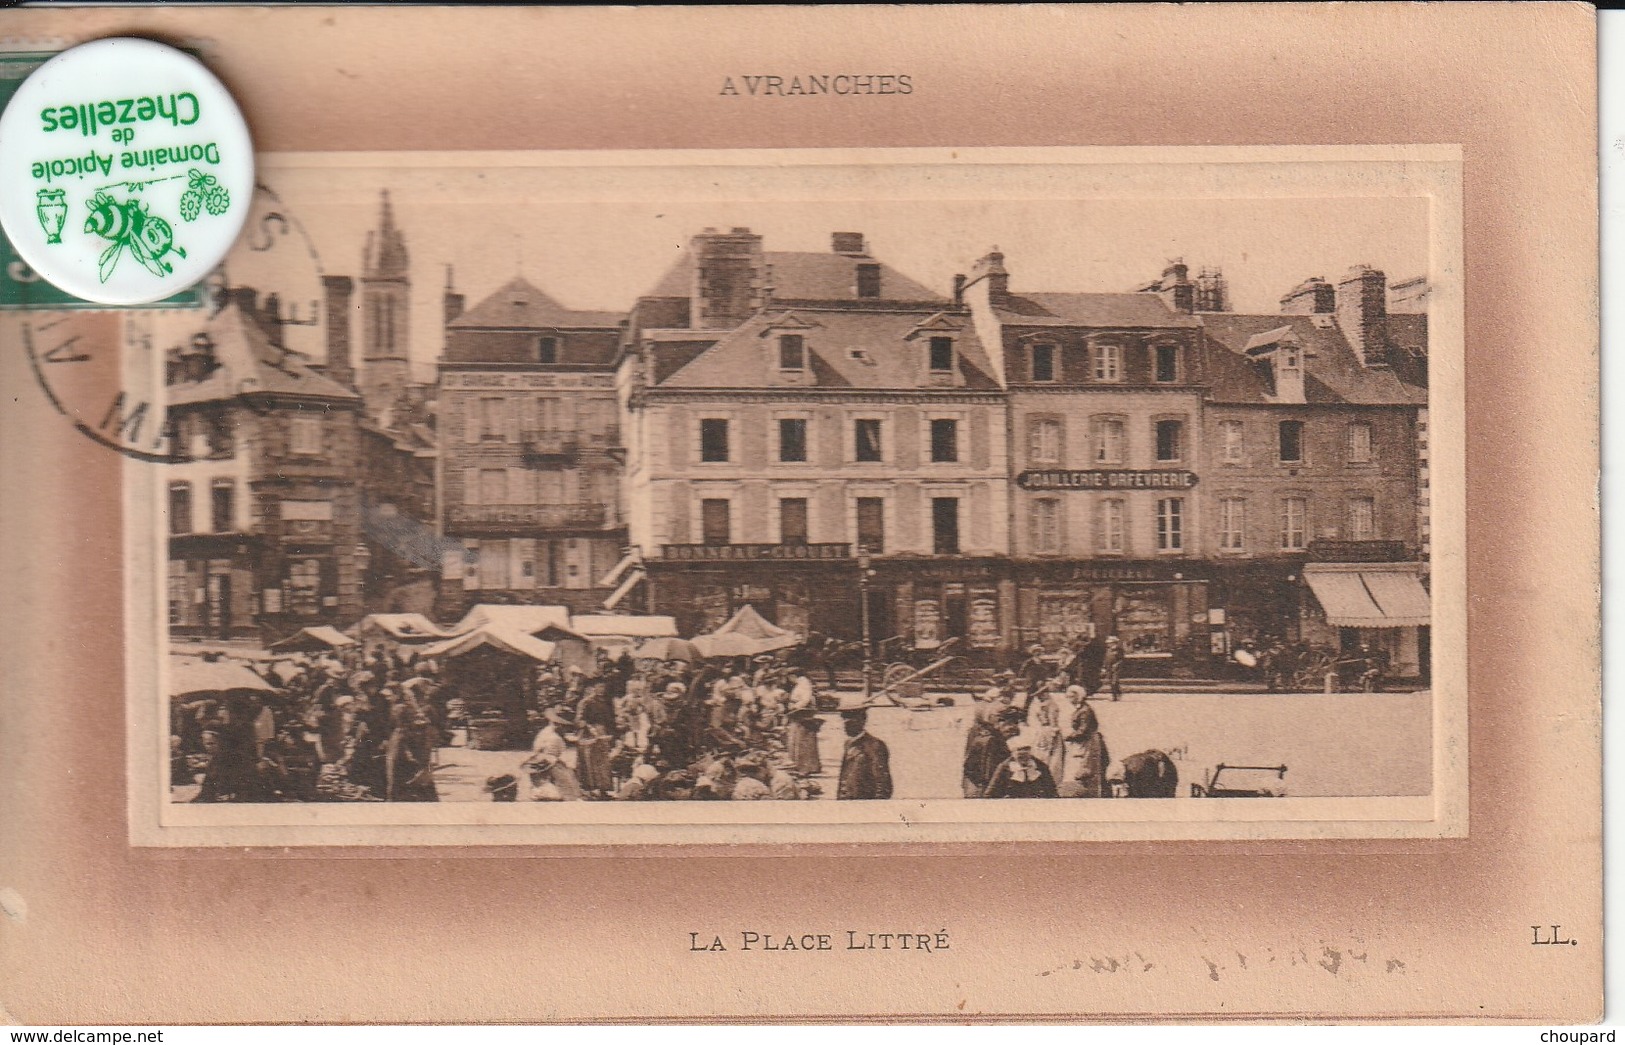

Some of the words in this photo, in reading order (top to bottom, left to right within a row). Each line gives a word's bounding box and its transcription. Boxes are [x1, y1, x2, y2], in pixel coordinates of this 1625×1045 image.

[719, 74, 913, 96] AVRANCHES
[41, 92, 200, 136] Chezelles
[112, 128, 134, 146] de
[32, 150, 113, 183] Apicole
[121, 143, 220, 171] Domaine
[1530, 924, 1578, 946] LL.
